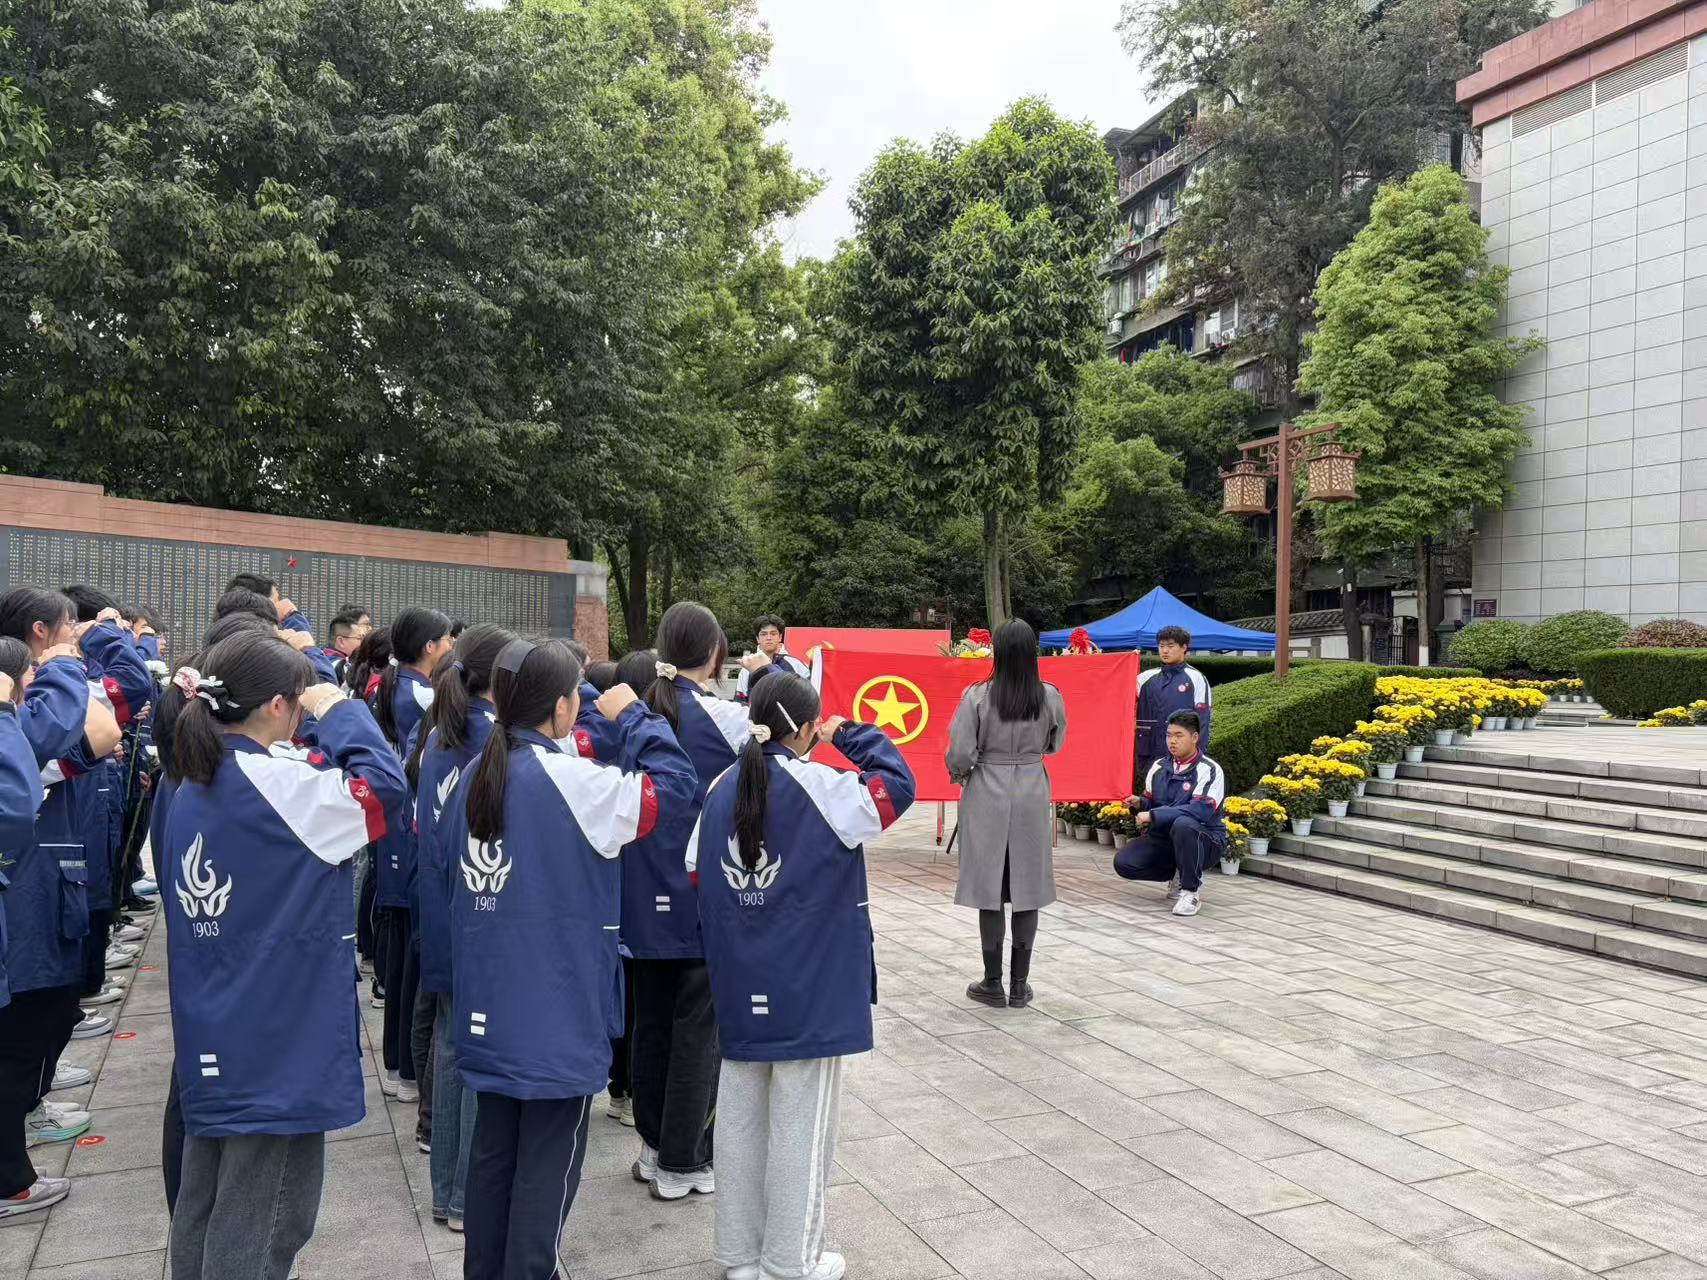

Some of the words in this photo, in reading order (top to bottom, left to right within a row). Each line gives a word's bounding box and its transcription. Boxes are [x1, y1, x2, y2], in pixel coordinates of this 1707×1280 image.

[474, 896, 496, 911] 1903
[738, 892, 764, 906] 1903
[192, 920, 219, 938] 1903
